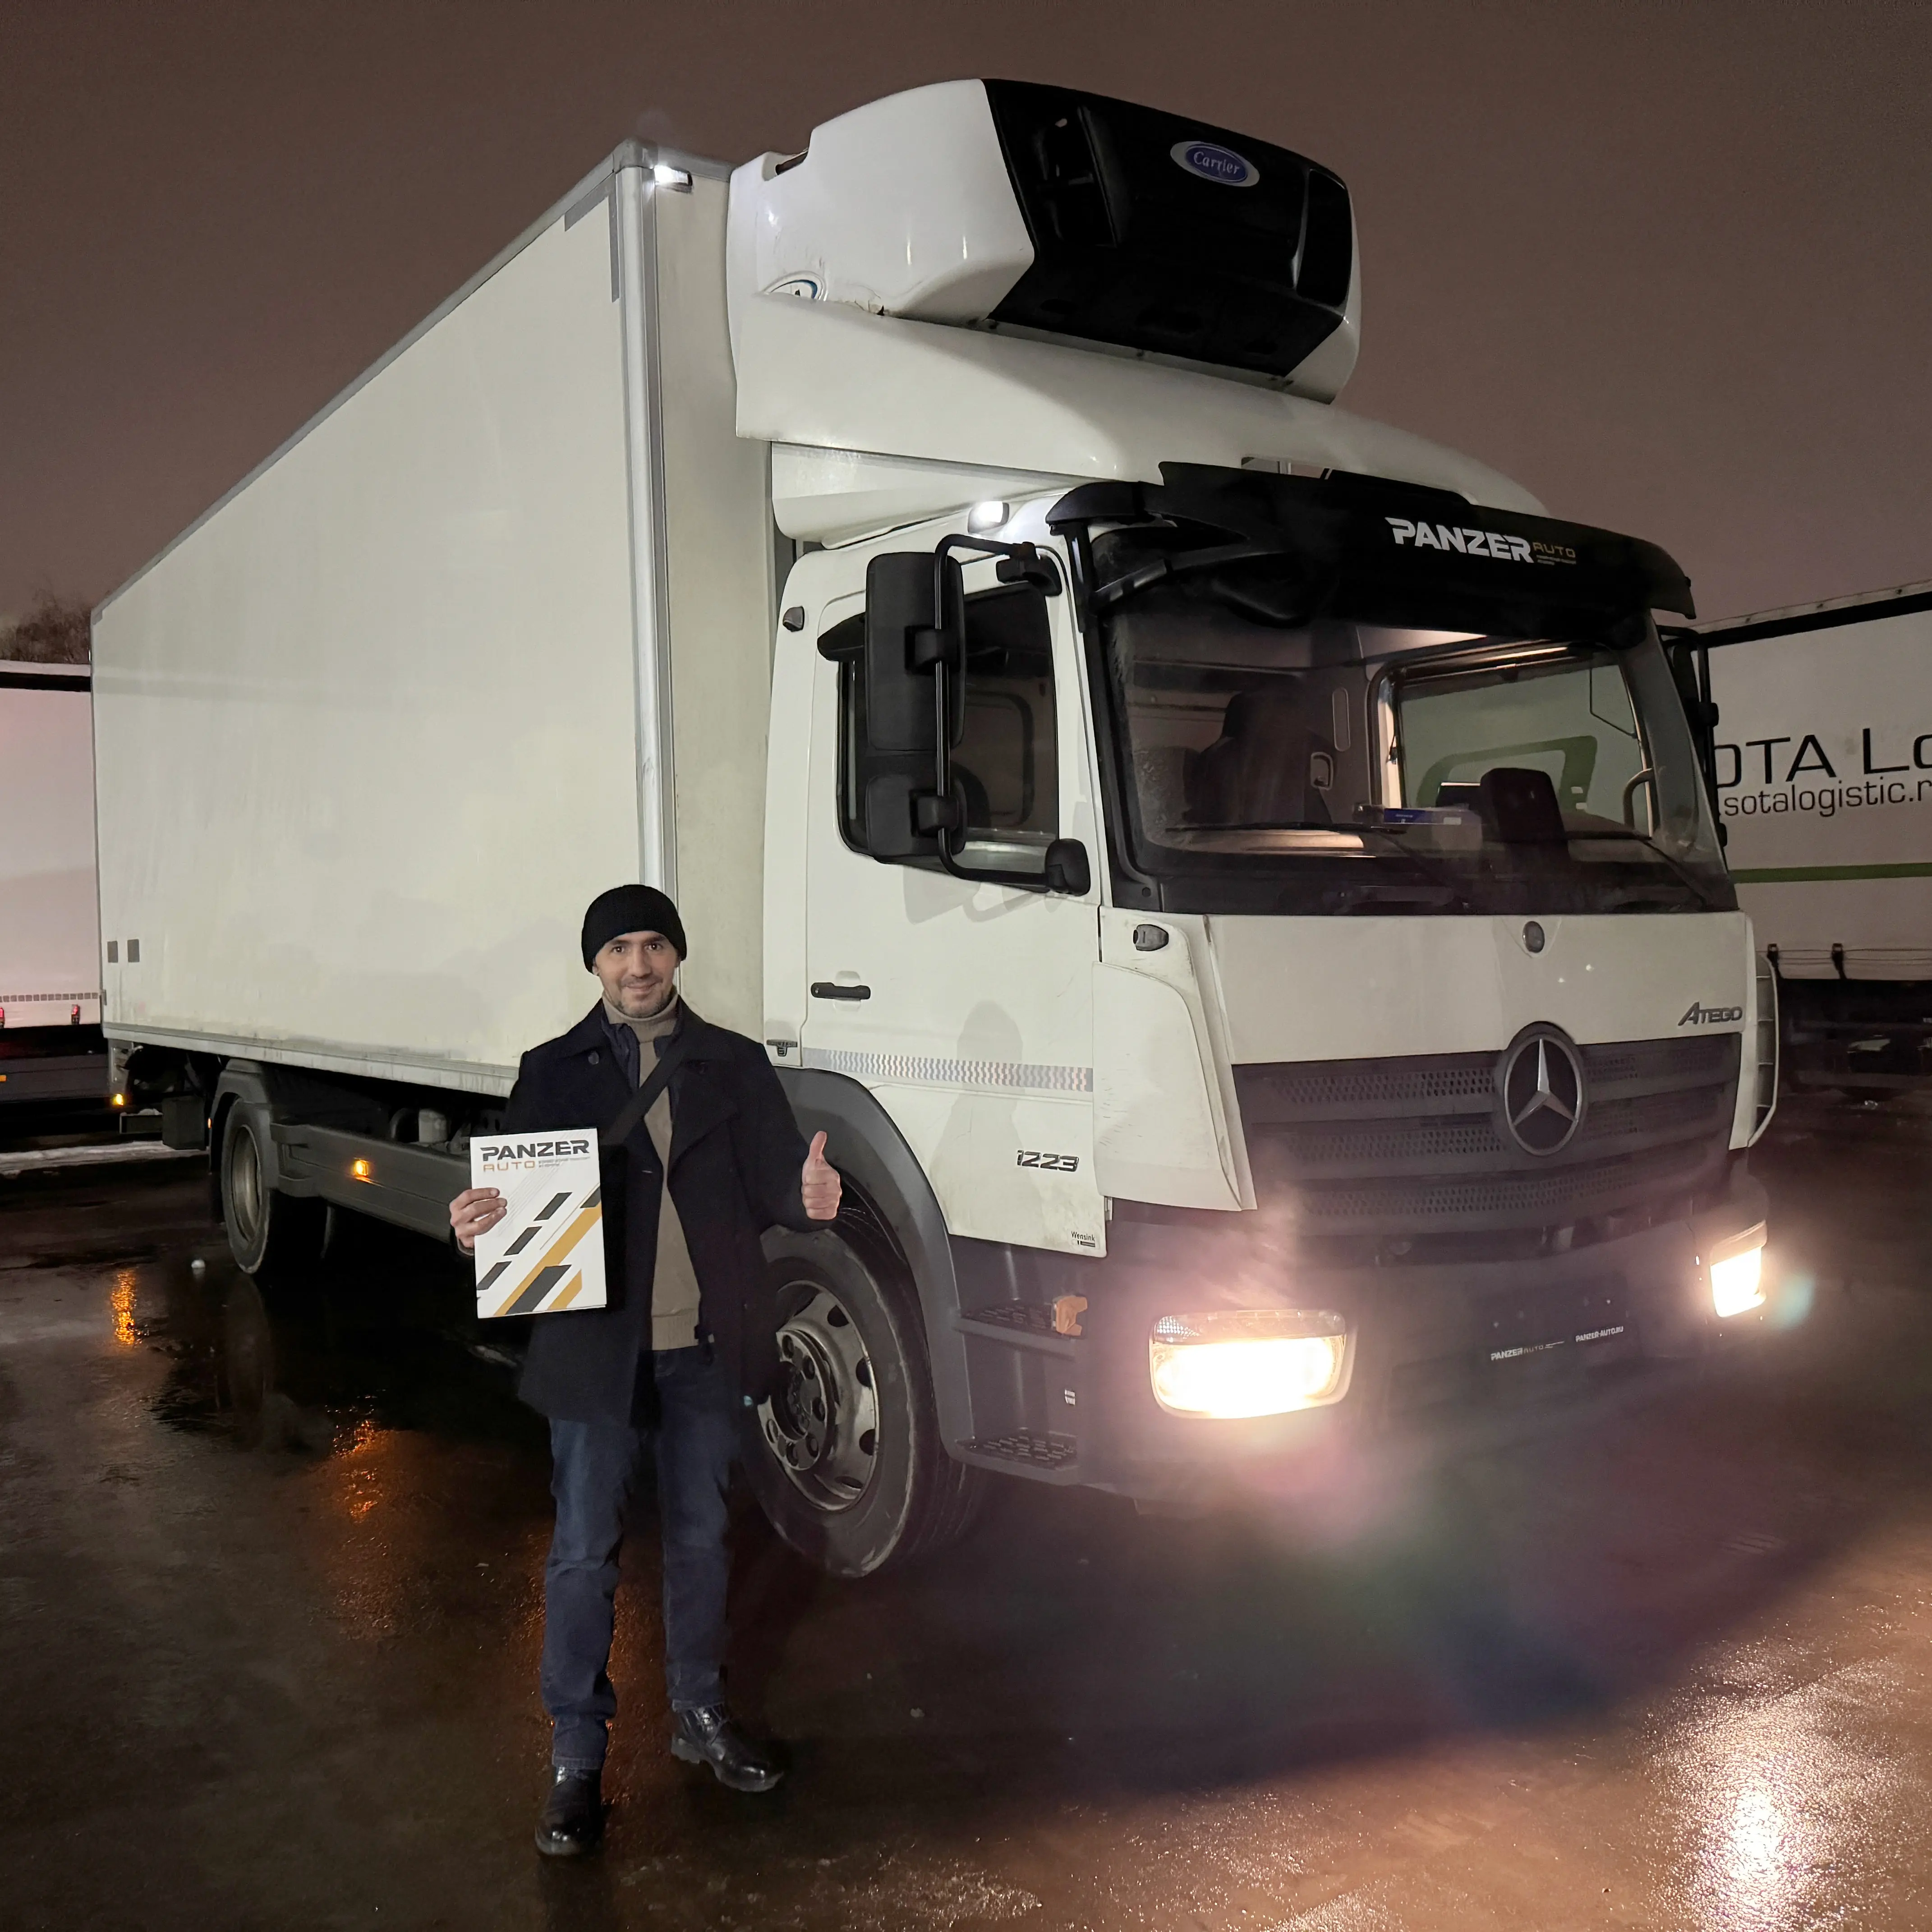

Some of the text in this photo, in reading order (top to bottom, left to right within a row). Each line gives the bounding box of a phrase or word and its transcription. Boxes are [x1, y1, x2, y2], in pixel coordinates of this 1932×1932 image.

[1193, 151, 1239, 175] Carrier
[1385, 517, 1576, 563] PANZER AUTO
[480, 1139, 590, 1162] PANZER
[1017, 1150, 1079, 1172] 1223
[483, 1160, 535, 1173] AUTO
[1071, 1231, 1095, 1242] Wensink
[1490, 1345, 1544, 1361] PANZER AUTO
